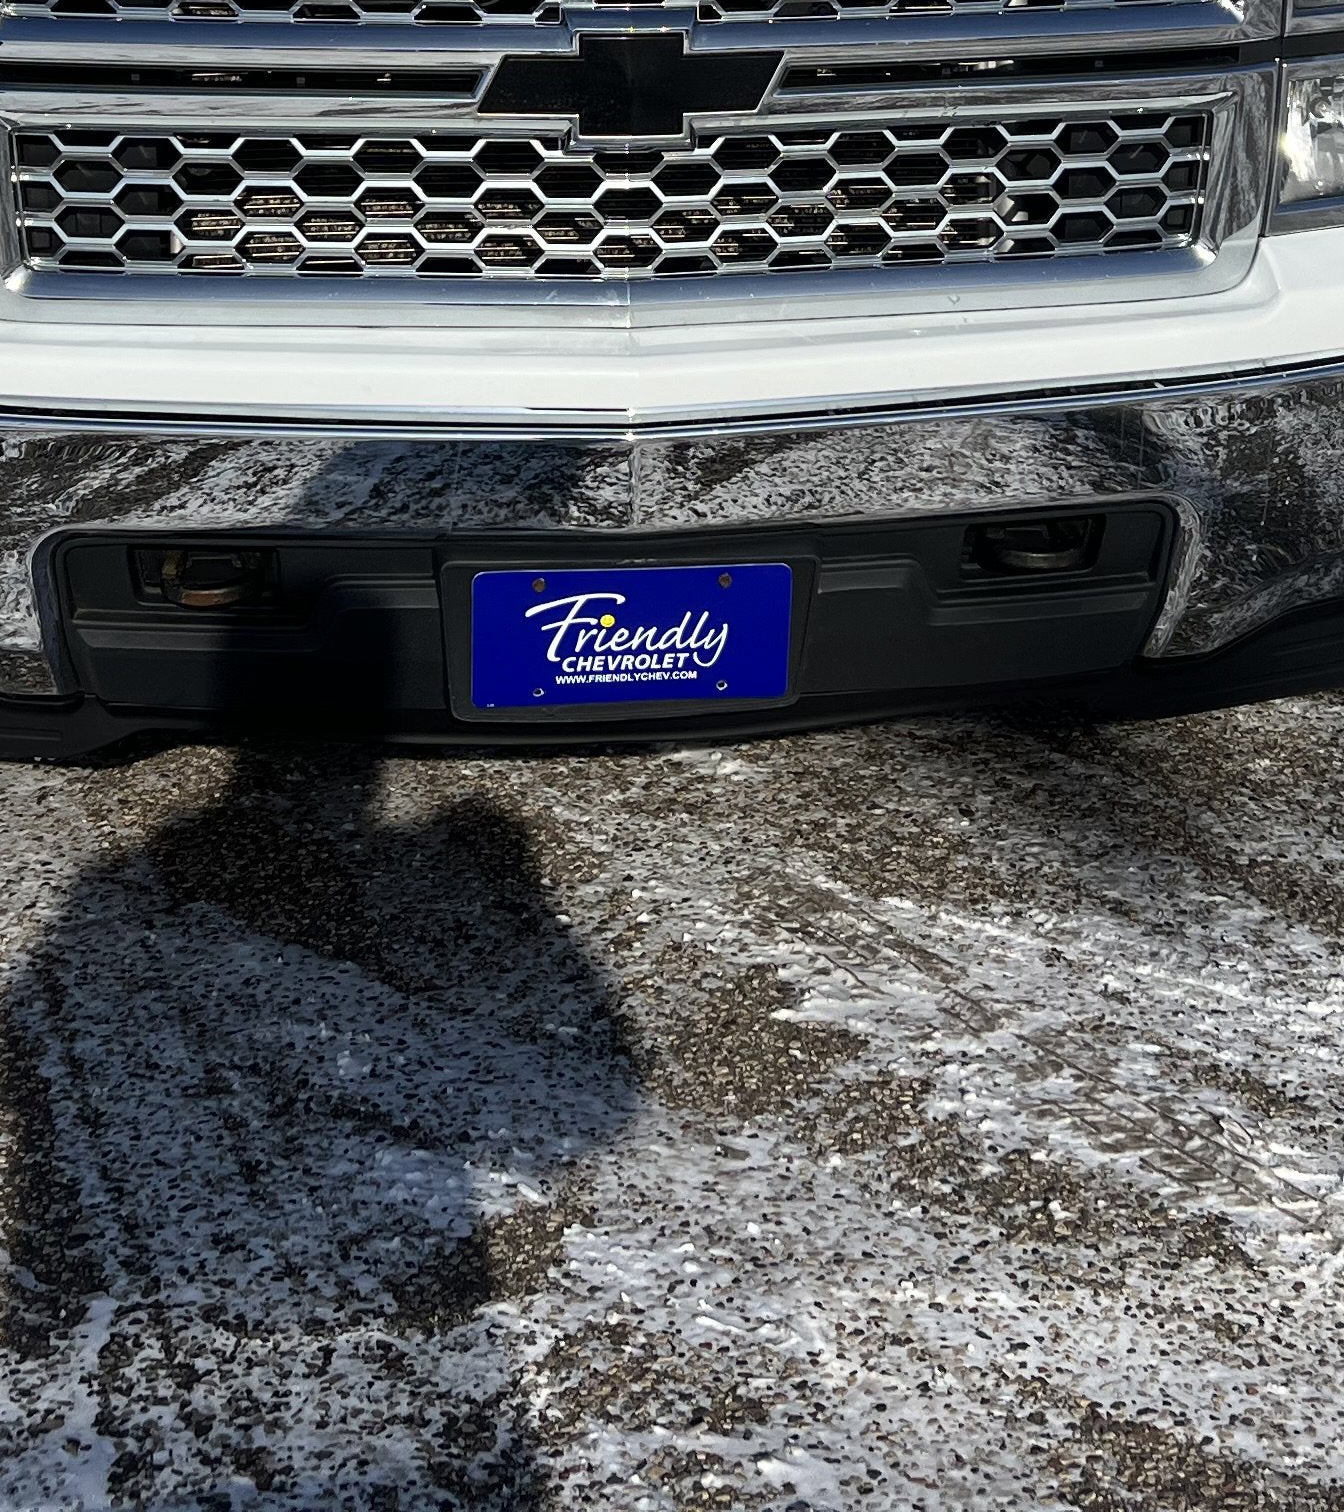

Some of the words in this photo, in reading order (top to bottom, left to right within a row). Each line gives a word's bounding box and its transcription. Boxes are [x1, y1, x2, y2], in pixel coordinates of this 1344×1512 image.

[525, 593, 729, 667] Friendly
[561, 652, 690, 673] CHEVROLET
[555, 670, 698, 685] WWW.FRIENDLYCHEV.COM
